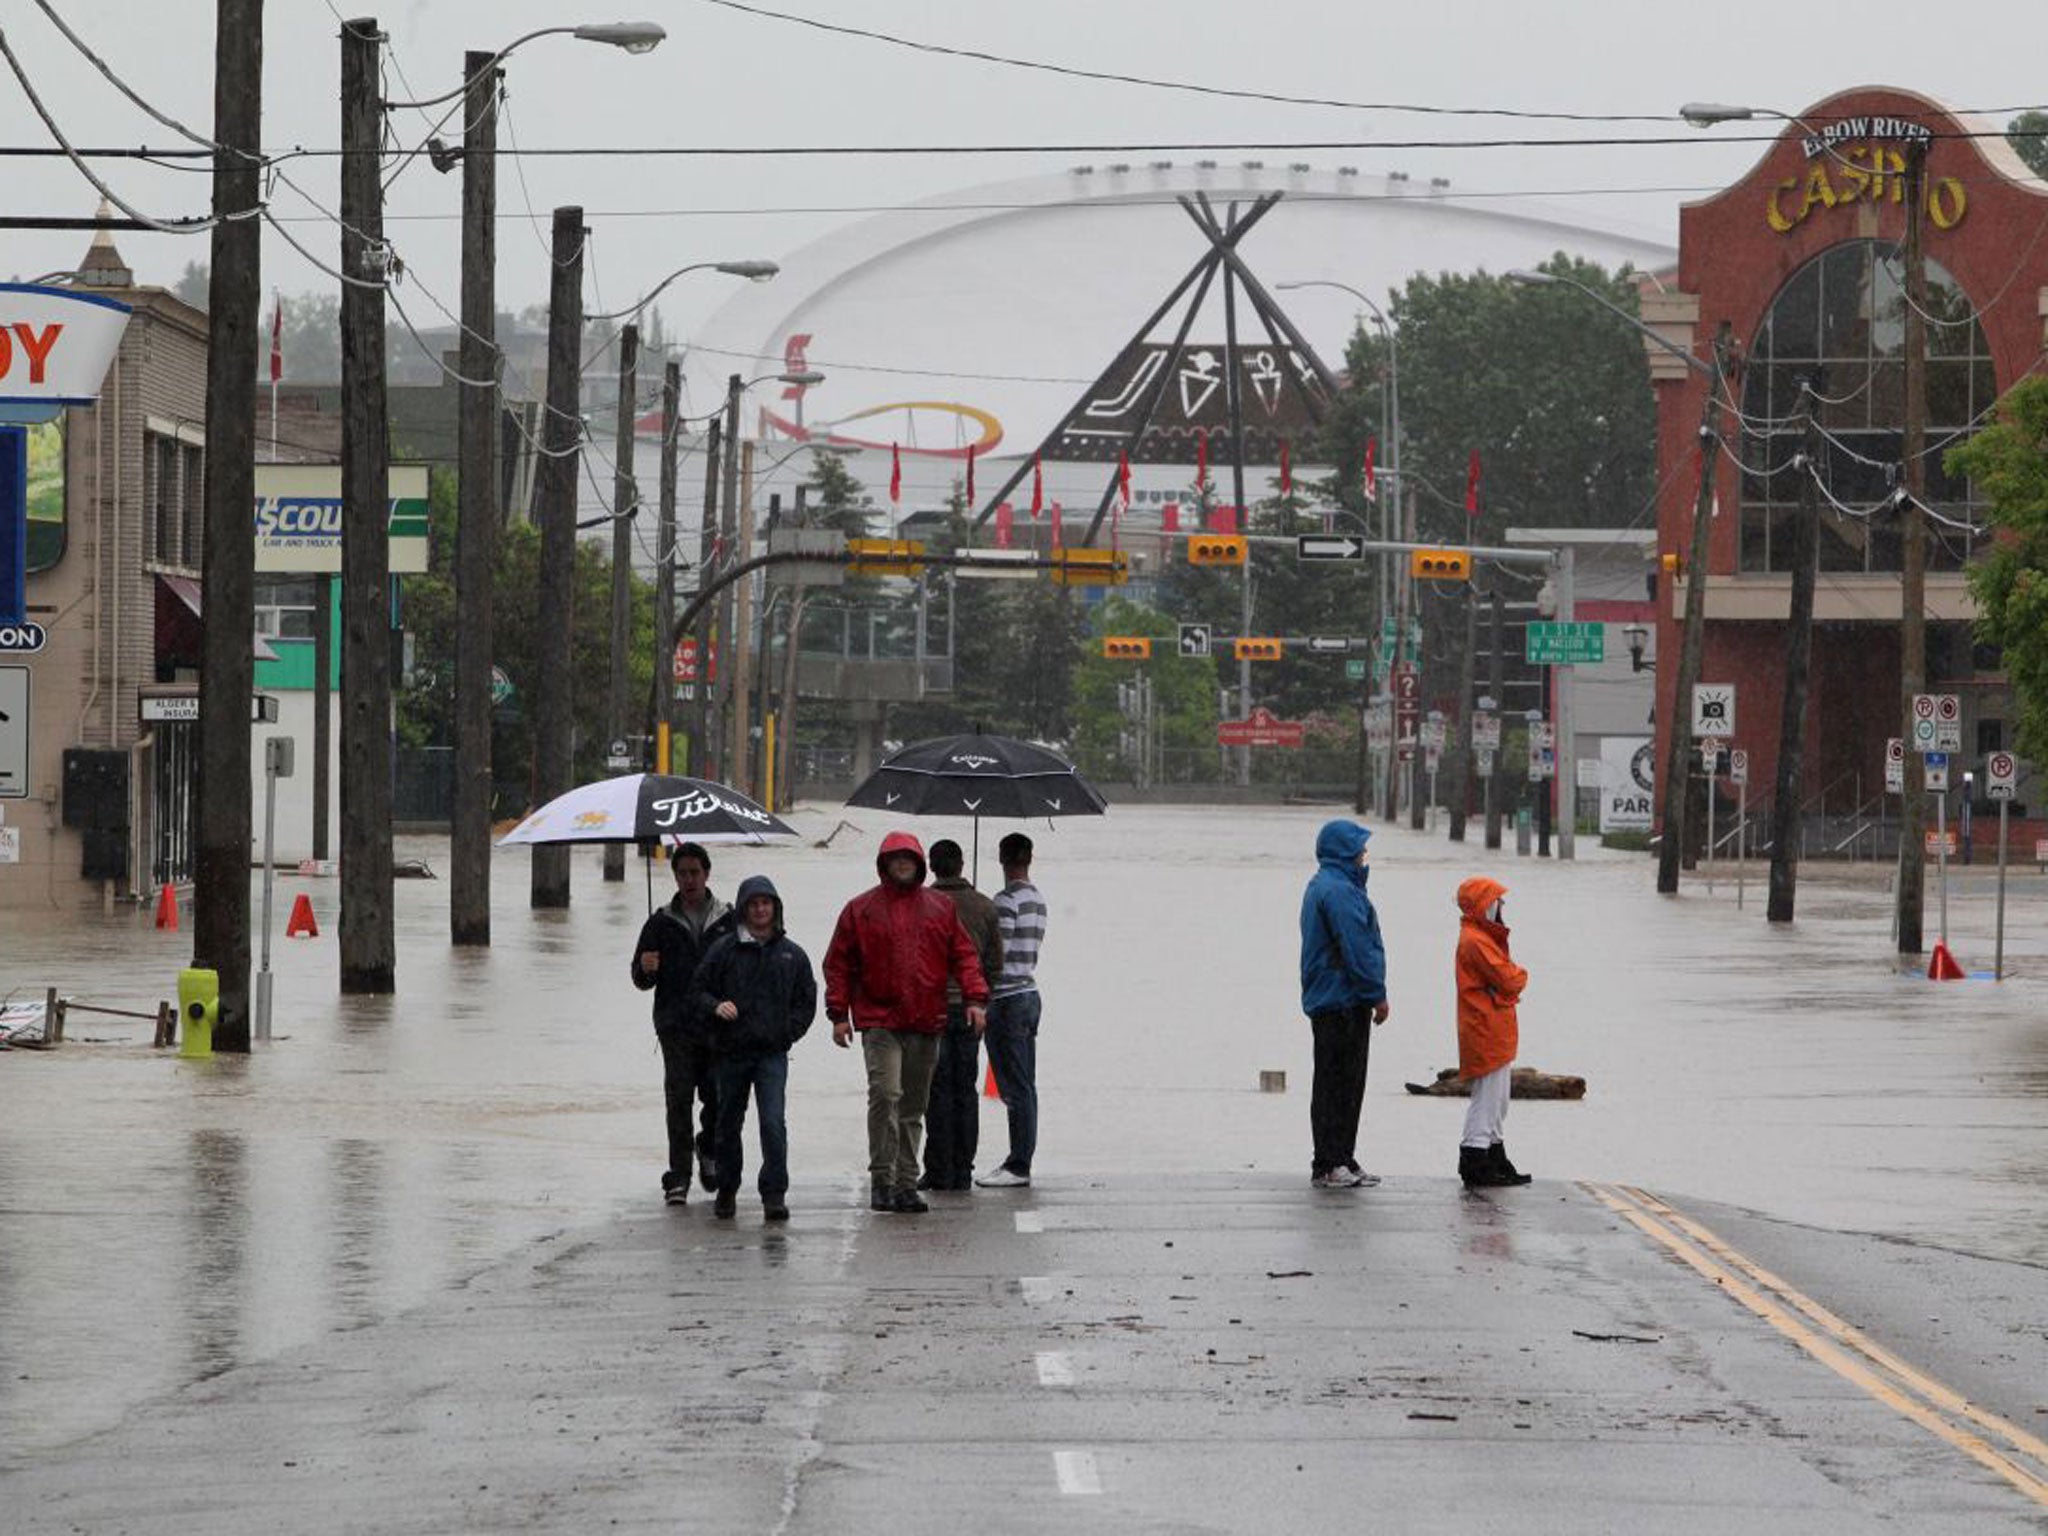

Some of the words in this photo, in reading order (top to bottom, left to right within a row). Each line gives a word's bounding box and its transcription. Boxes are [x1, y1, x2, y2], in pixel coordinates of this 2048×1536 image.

[1767, 147, 1967, 231] CASINO
[255, 497, 342, 536] SCOU
[285, 538, 303, 547] AND
[163, 709, 198, 718] INSURA
[1613, 797, 1650, 813] PAR
